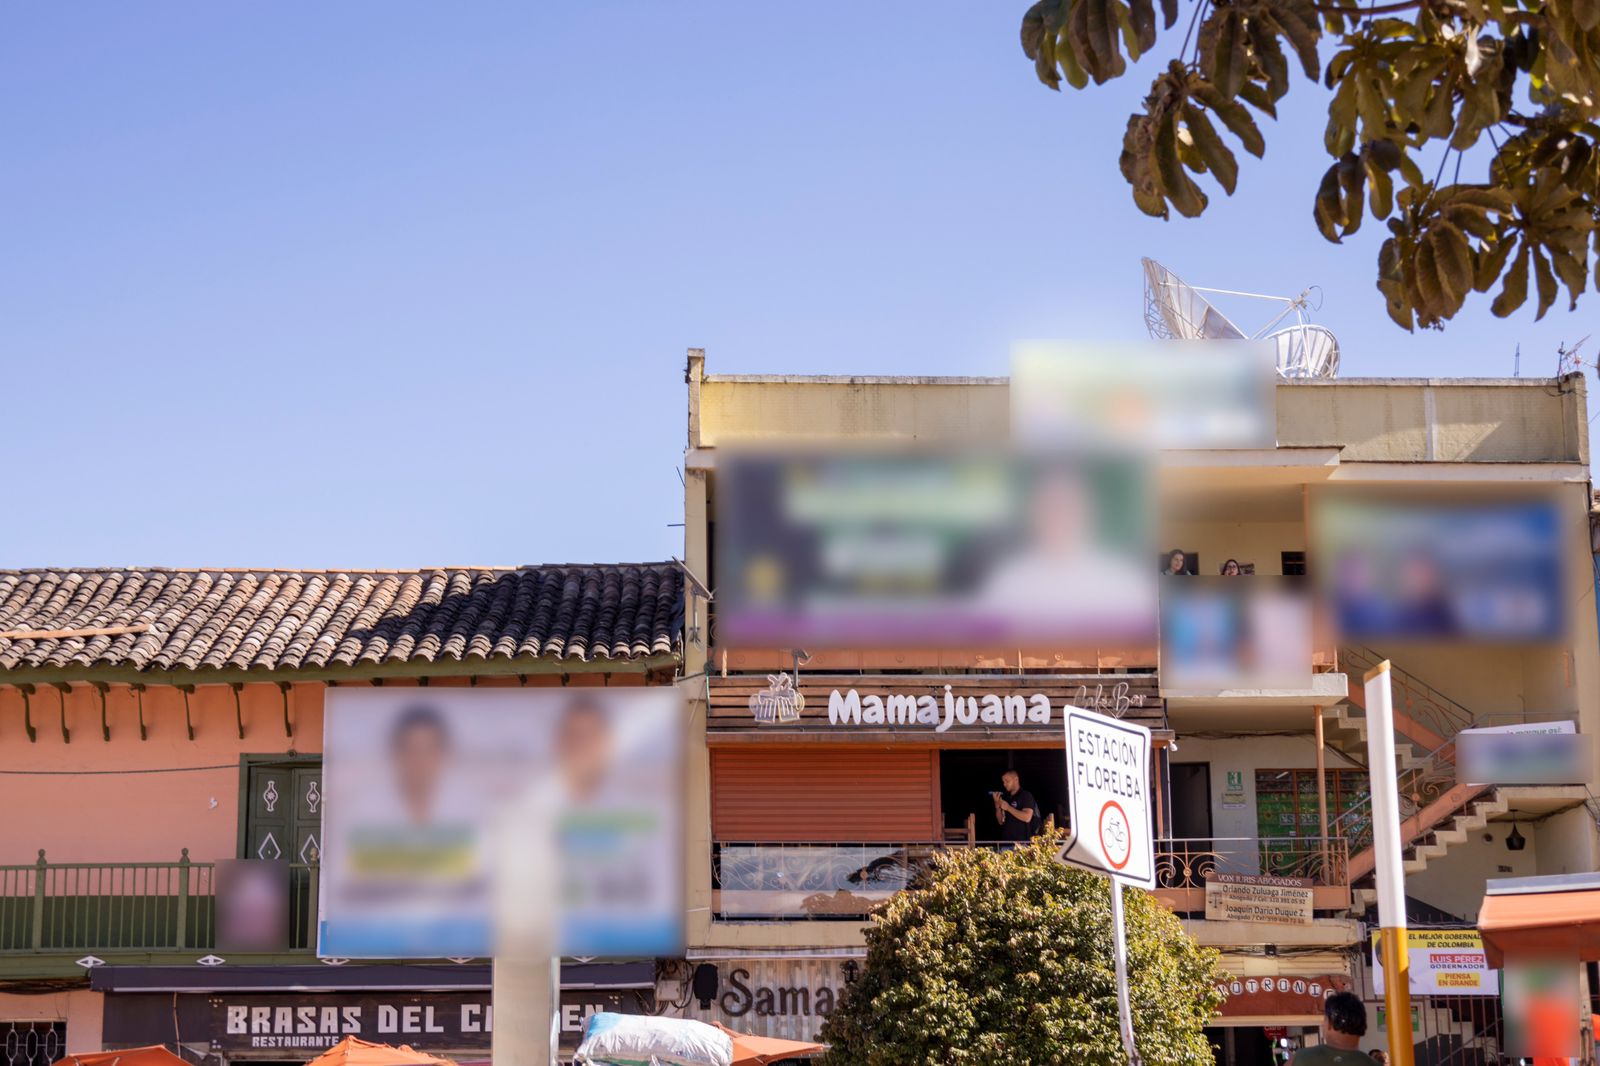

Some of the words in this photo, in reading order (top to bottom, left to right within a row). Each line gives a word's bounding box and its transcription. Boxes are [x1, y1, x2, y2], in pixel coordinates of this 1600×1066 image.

[1113, 682, 1147, 711] Bar
[828, 684, 1051, 733] Mamajuana
[1078, 729, 1137, 768] ESTACIÓN
[1077, 761, 1142, 801] FLORELBA
[1218, 874, 1234, 882] VOX
[1258, 877, 1302, 887] ABOGADOS
[1222, 884, 1250, 894] Orlando
[1252, 887, 1279, 897] Zuluaga
[1280, 889, 1309, 898] Jiménez
[1275, 908, 1298, 918] Duque
[1431, 955, 1453, 963] LUIS
[227, 1005, 362, 1034] BRASAS
[378, 1004, 444, 1033] DEL
[461, 1003, 604, 1032] CEN
[252, 1036, 340, 1047] RESTAURANTE
